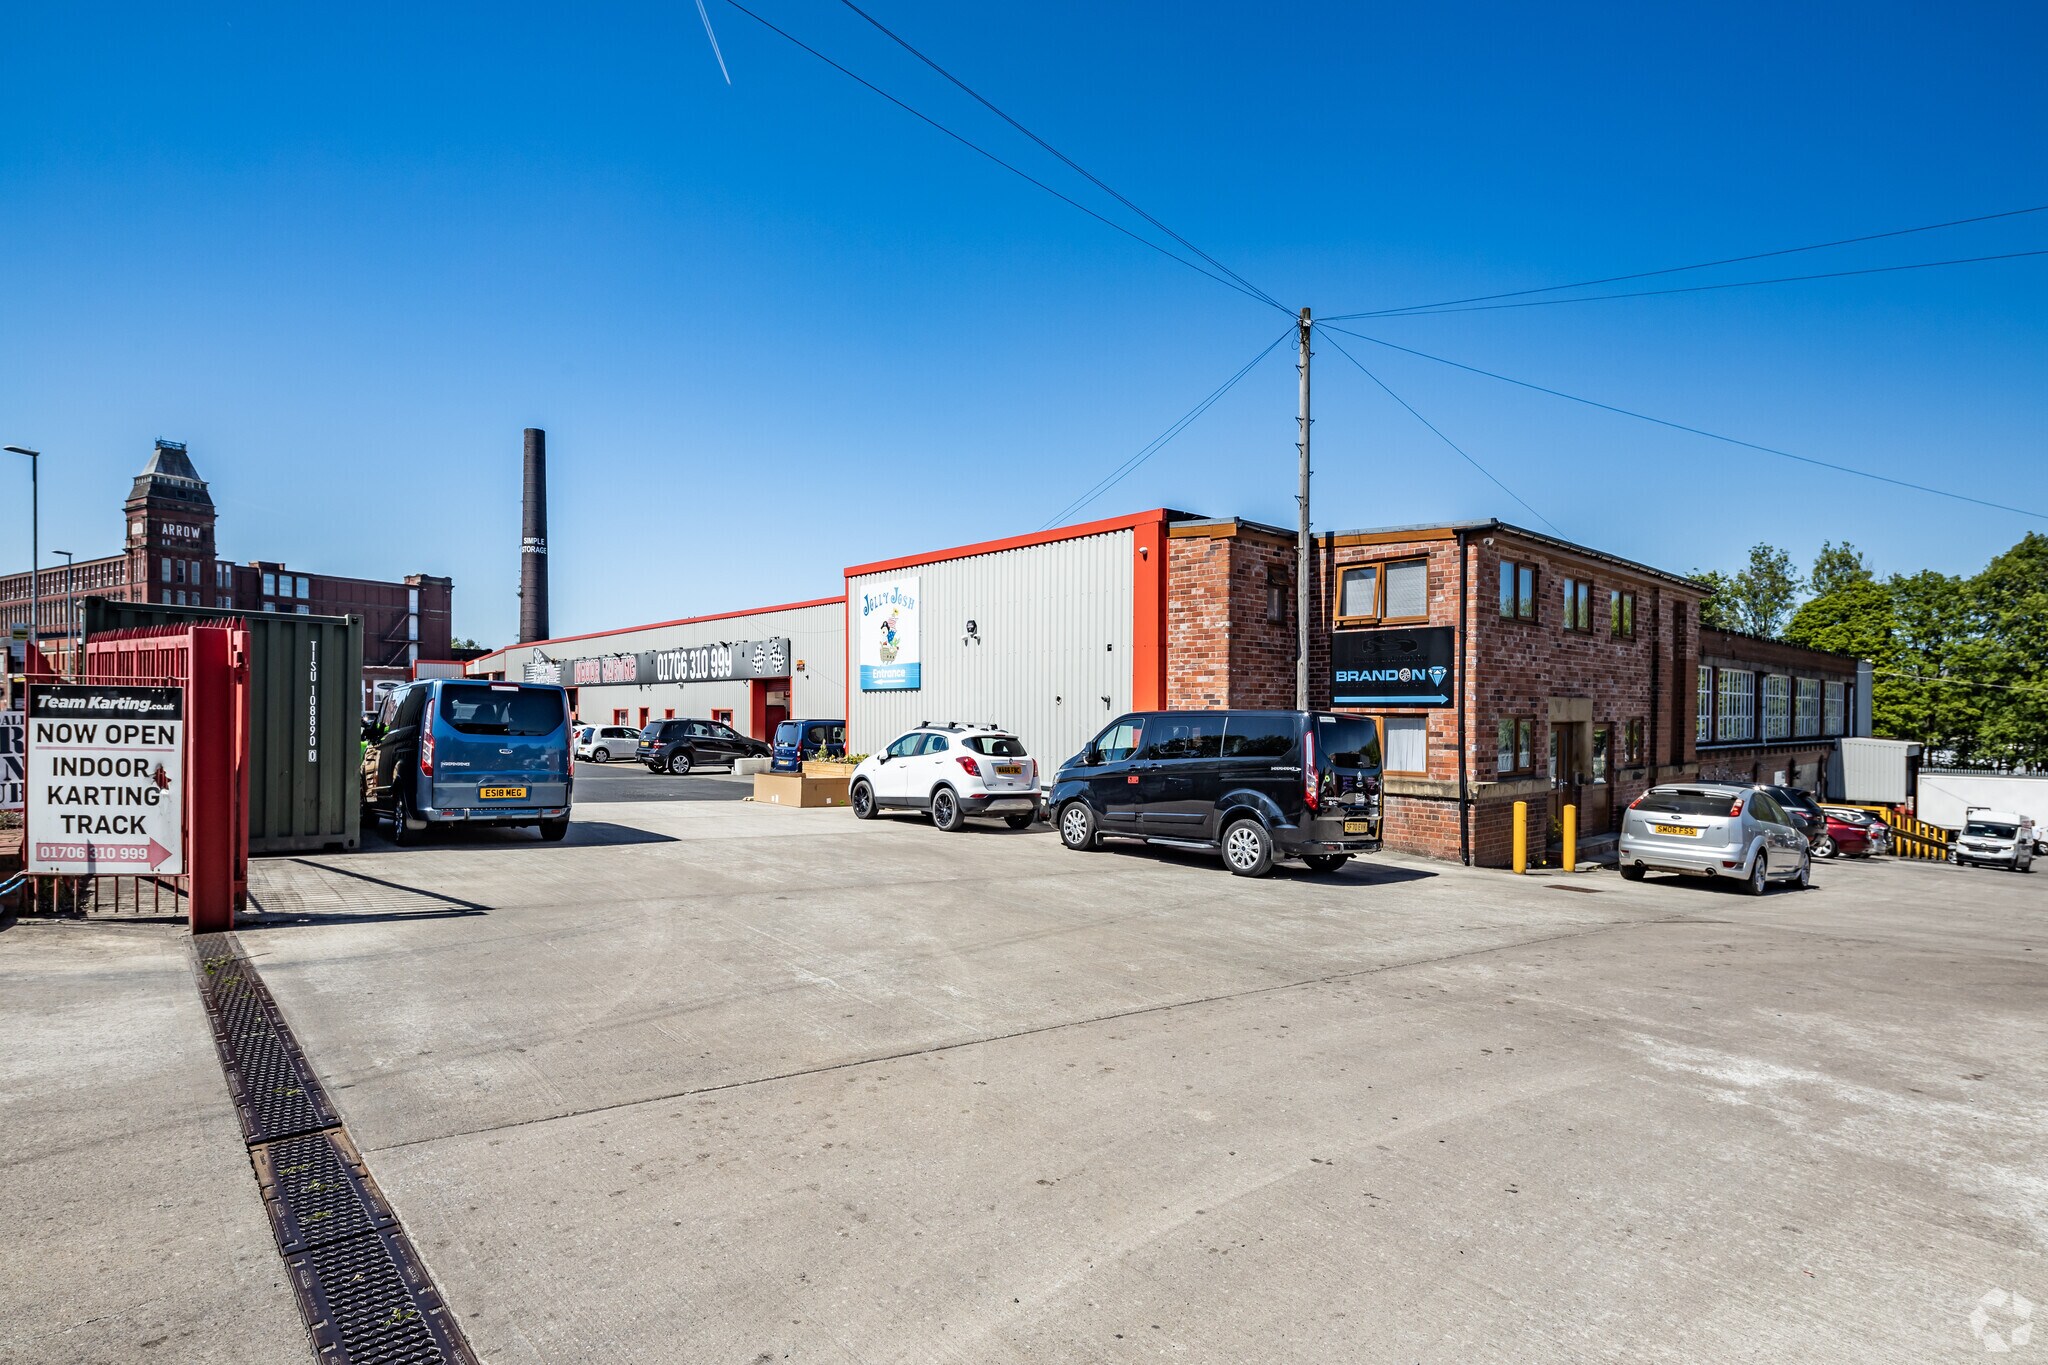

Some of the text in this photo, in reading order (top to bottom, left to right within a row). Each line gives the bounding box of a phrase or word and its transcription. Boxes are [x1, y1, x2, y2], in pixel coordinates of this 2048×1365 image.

[162, 523, 200, 539] ARROW
[523, 537, 545, 545] SIMPLE
[521, 545, 547, 555] STORAGE
[574, 659, 601, 684] INDOOR
[602, 655, 637, 683] KARTING
[656, 646, 733, 681] 01706 310 999
[872, 667, 906, 679] Entrance
[1336, 667, 1426, 683] BRANDON
[38, 695, 86, 709] Team
[37, 723, 175, 745] NOW OPEN
[52, 757, 150, 778] INDOOR
[47, 785, 160, 806] KARTING
[485, 789, 504, 797] ES18
[60, 815, 147, 835] TRACK
[1678, 827, 1695, 835] FSS
[40, 846, 148, 860] 01706 310 999
